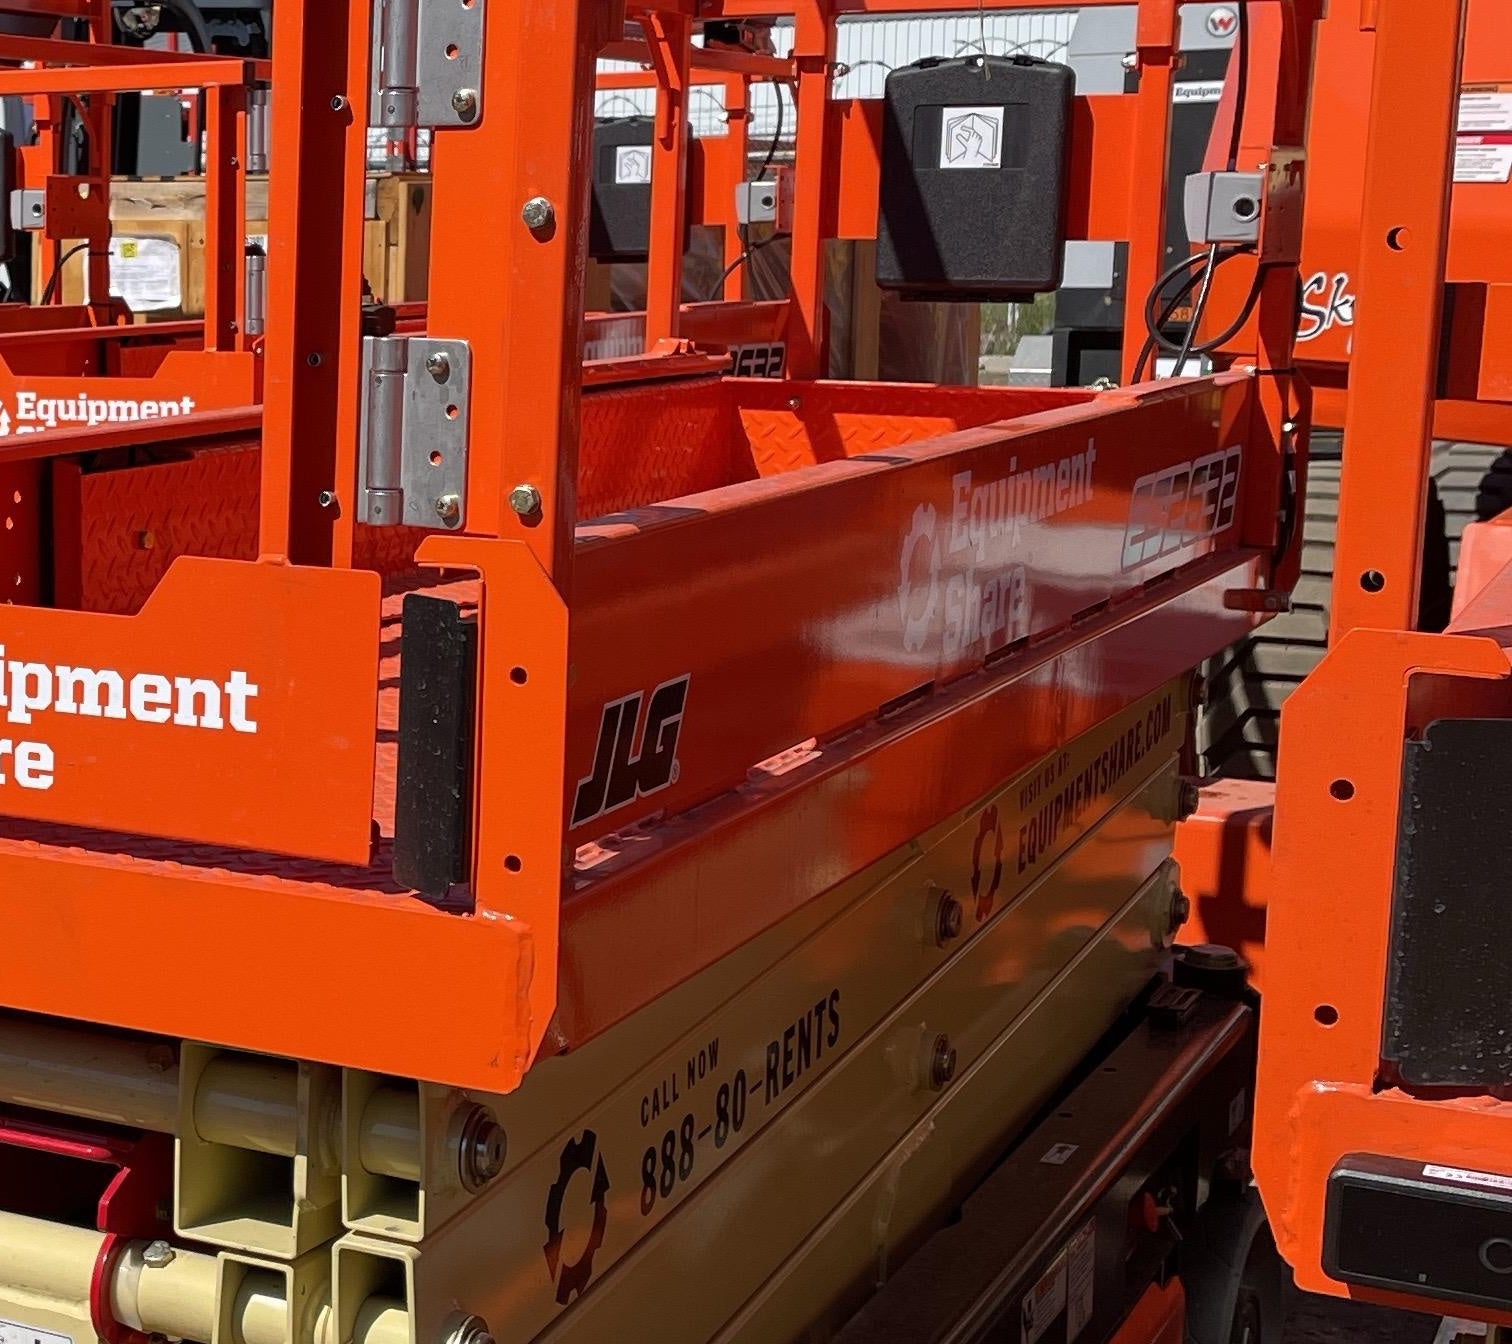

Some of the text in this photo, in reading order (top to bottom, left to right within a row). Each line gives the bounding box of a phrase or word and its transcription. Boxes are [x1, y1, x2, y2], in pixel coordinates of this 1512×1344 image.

[1175, 86, 1221, 98] Equipm
[1296, 272, 1355, 355] Sk
[15, 391, 196, 426] Equipment
[949, 437, 1097, 563] Equipment
[569, 673, 691, 830] JLG
[1018, 693, 1172, 875] EQUIPMENTSHARE.COM
[1019, 779, 1043, 812] VISIT
[638, 988, 842, 1217] 888-80-RENTS
[639, 1037, 721, 1128] CALL NOW
